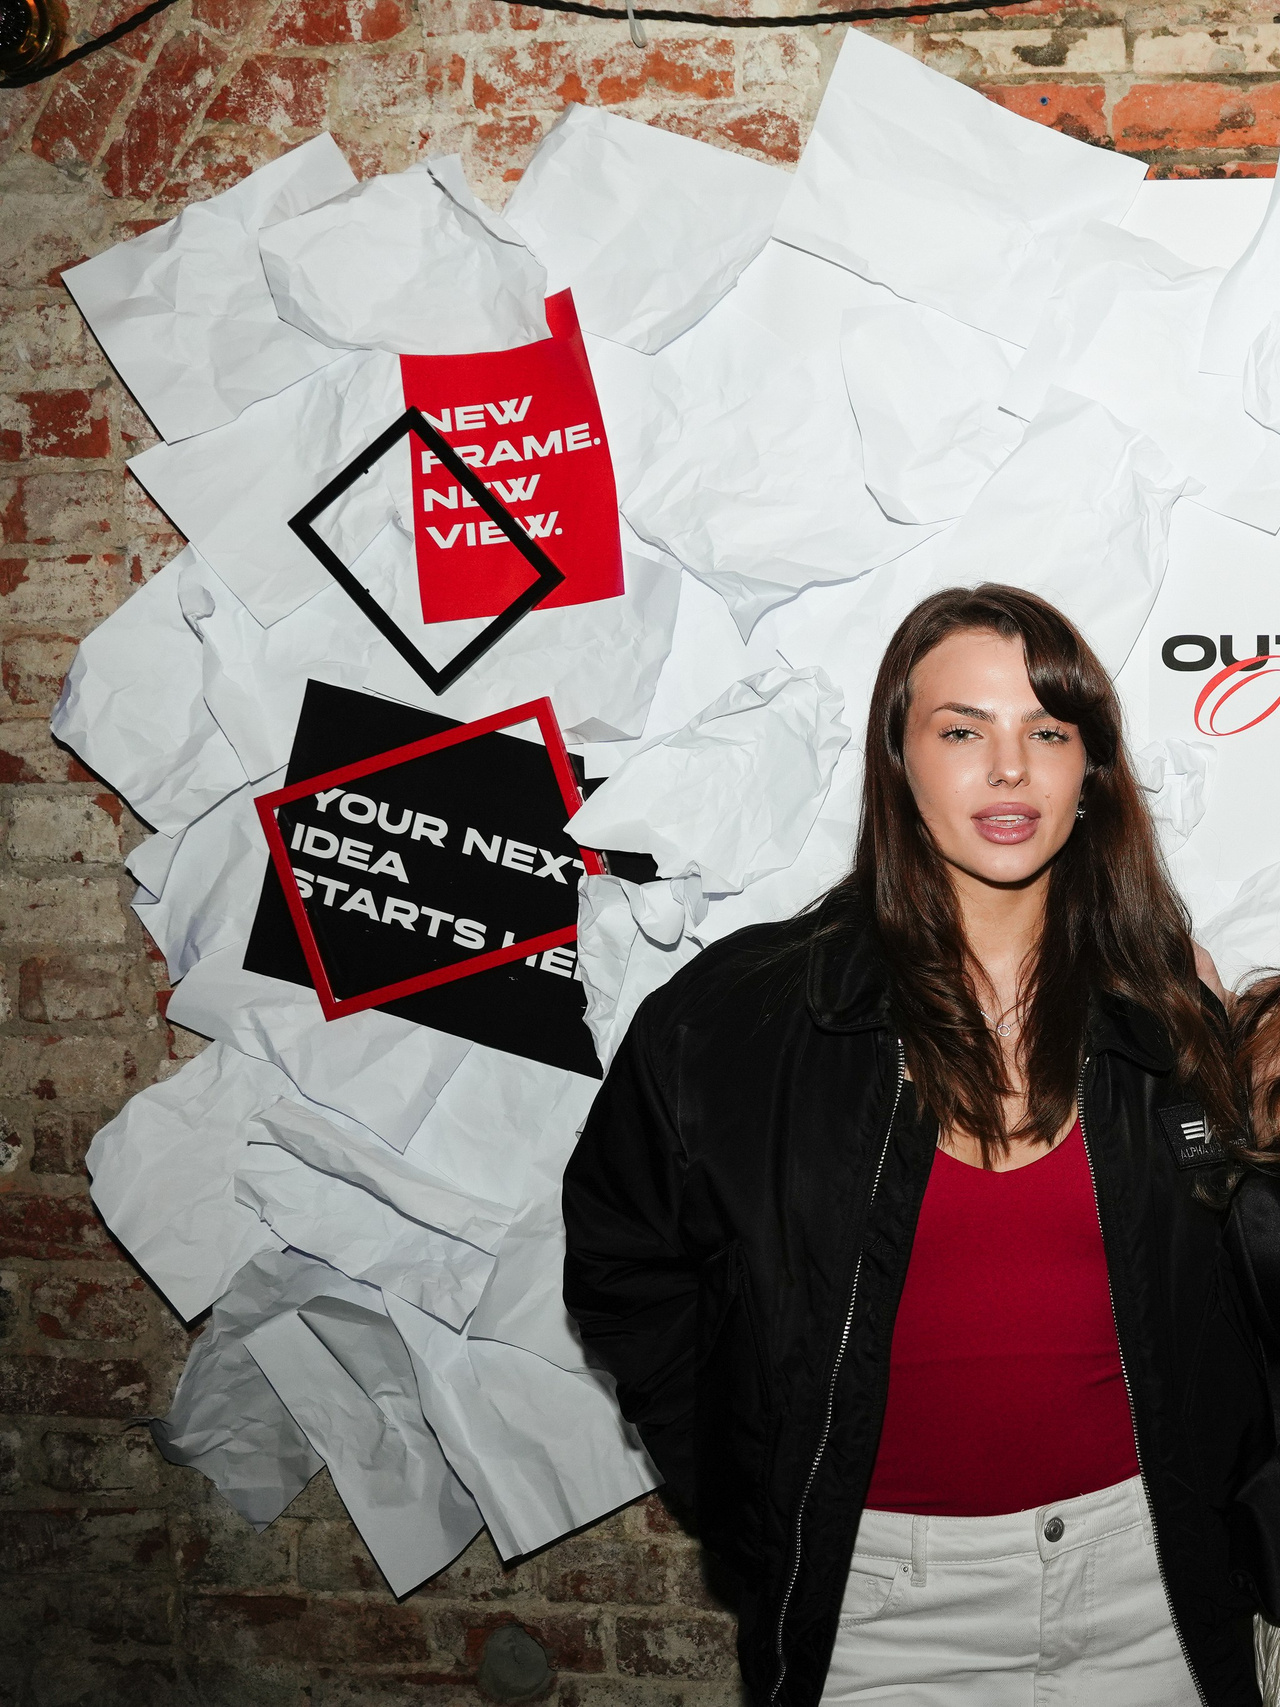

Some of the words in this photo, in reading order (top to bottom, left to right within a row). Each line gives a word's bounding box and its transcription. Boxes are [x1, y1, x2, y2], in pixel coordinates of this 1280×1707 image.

[420, 395, 533, 433] NEW
[421, 422, 601, 475] FRAME.
[425, 511, 563, 549] VIEW.
[314, 788, 449, 848] YOUR
[290, 822, 410, 884] IDEA
[292, 867, 487, 950] STARTS
[1180, 1145, 1208, 1159] ALPHA
